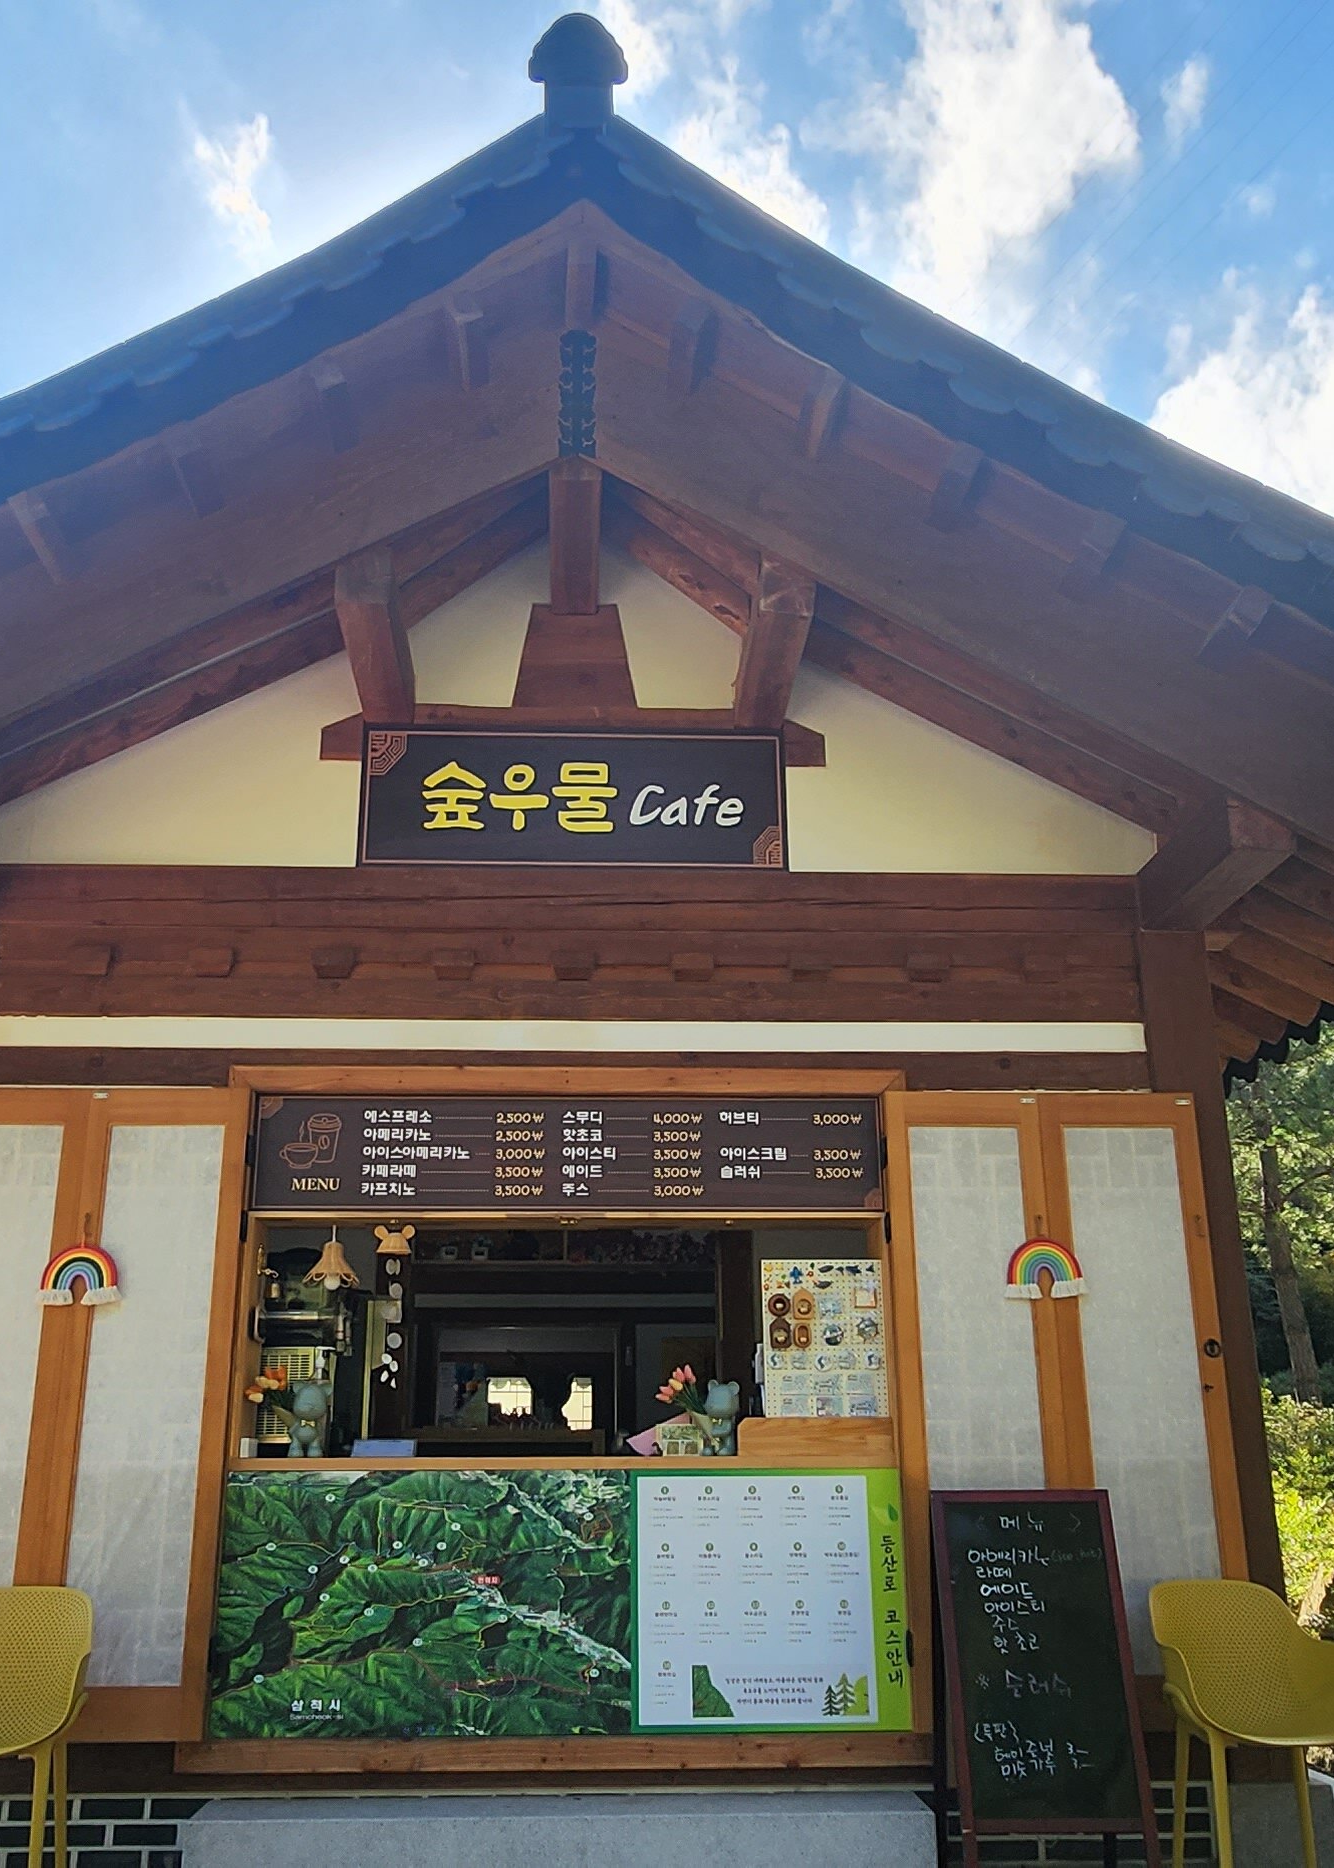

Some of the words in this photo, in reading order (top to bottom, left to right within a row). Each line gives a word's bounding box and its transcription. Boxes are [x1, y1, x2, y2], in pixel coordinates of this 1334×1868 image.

[422, 761, 618, 833] 숲우물
[629, 784, 744, 827] Cafe
[364, 1110, 432, 1124] 에스프레소
[562, 1111, 603, 1125] 스무디
[719, 1111, 759, 1125] 허브티
[363, 1128, 432, 1142] 아메리카노
[562, 1128, 603, 1142] 핫초코
[362, 1146, 470, 1160] 아이스아메리카노
[562, 1146, 617, 1160] 아이스티
[719, 1147, 787, 1161] 아이스크림
[562, 1164, 603, 1178] 에이드
[720, 1165, 761, 1179] 슬러쉬
[291, 1177, 340, 1191] MENU
[361, 1182, 416, 1197] 카프치노
[562, 1182, 590, 1197] 주스
[880, 1534, 897, 1593] 등산로
[979, 1581, 1034, 1600] 에이드
[983, 1600, 1046, 1616] 아이스티
[991, 1614, 1020, 1633] 주스
[884, 1609, 905, 1689] 코스안내
